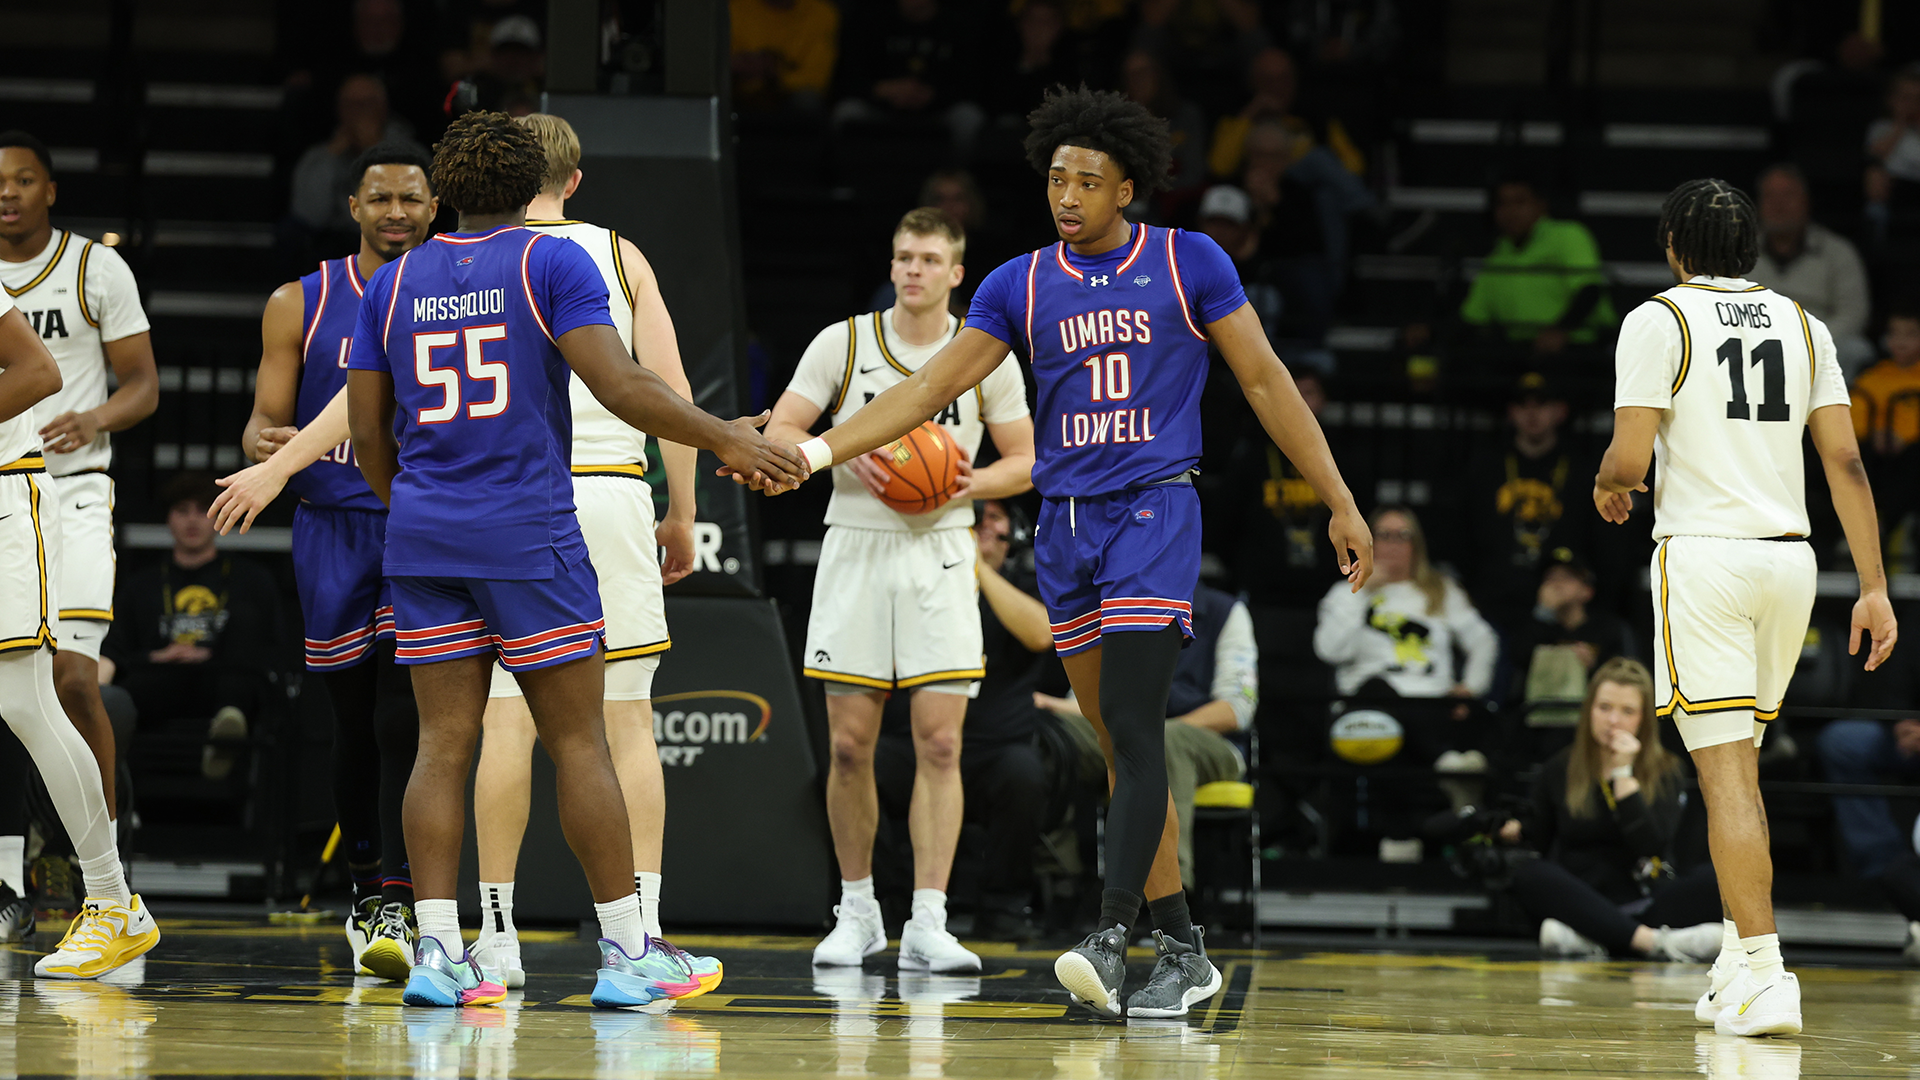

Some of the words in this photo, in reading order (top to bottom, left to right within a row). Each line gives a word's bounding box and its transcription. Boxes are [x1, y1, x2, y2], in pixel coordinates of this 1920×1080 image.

[413, 288, 505, 323] MASSAQUOI
[1715, 301, 1772, 329] COMBS
[1058, 308, 1153, 354] UMASS
[412, 322, 511, 426] 55
[1082, 352, 1132, 402] 10
[1716, 337, 1790, 422] 11
[1061, 407, 1157, 448] LOWELL
